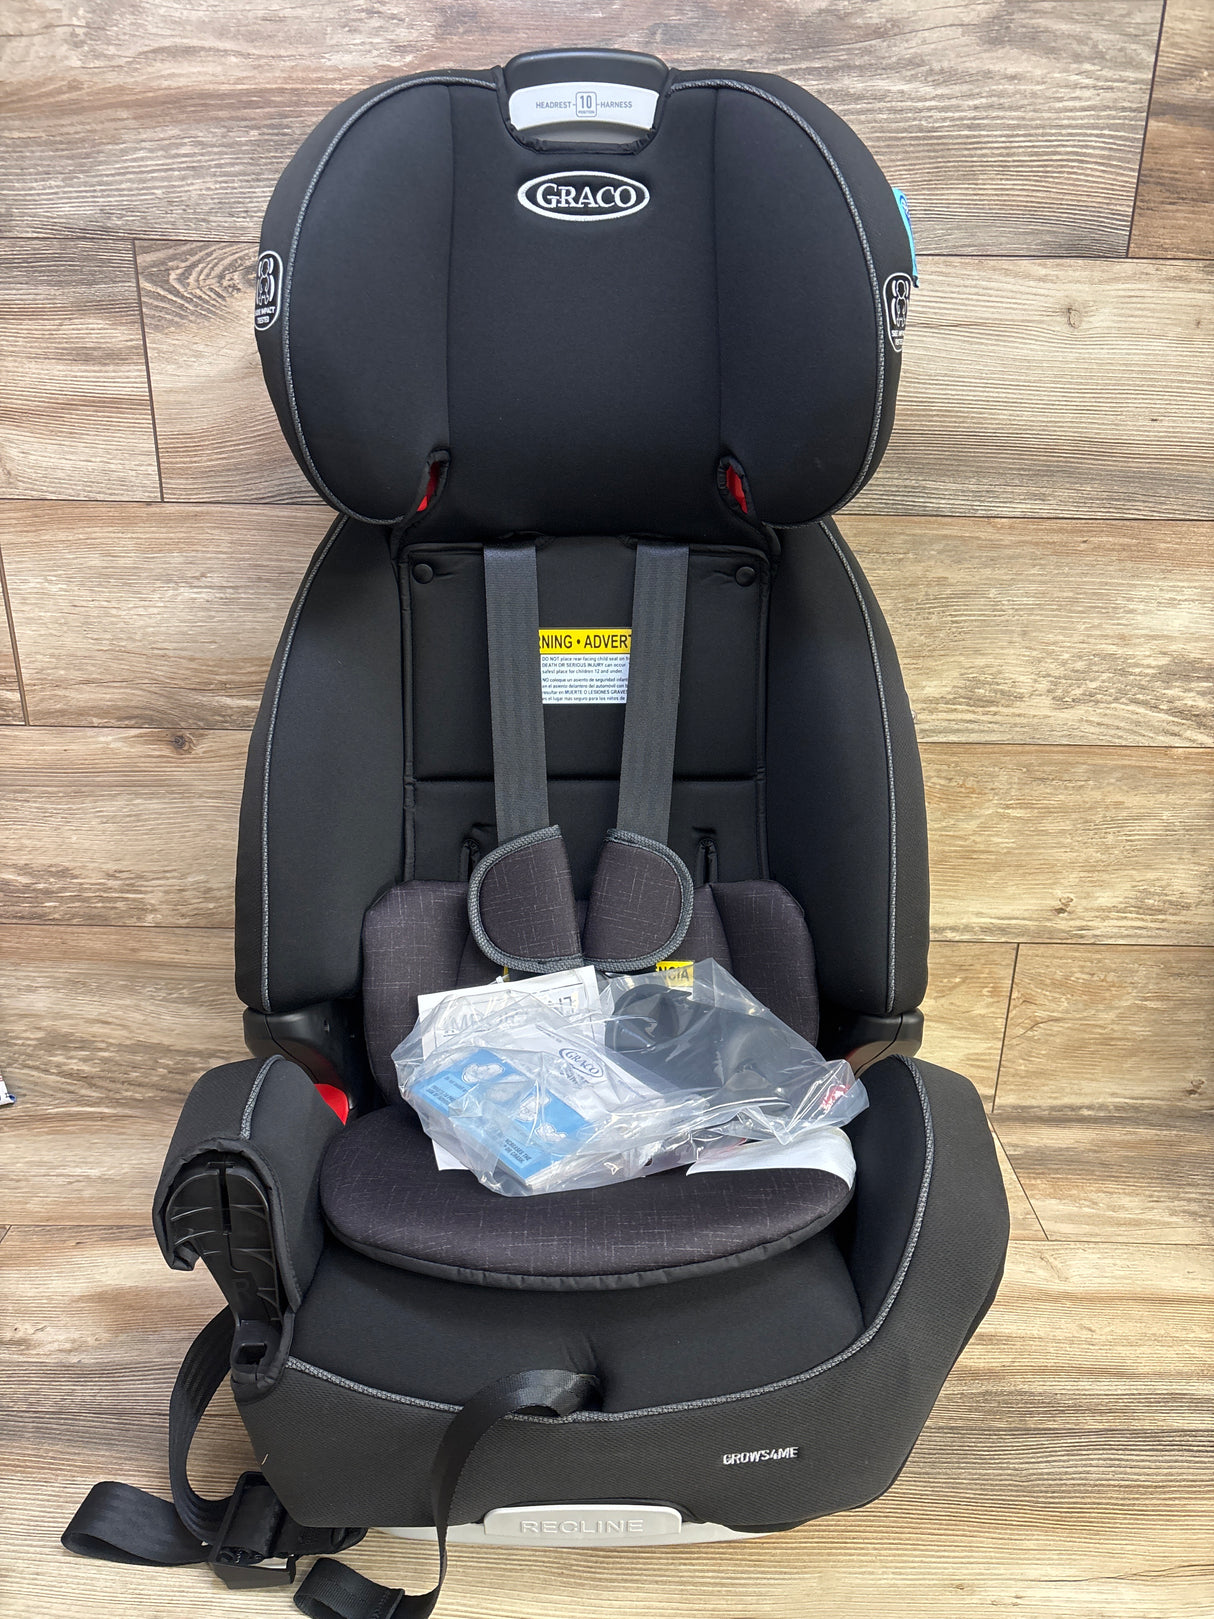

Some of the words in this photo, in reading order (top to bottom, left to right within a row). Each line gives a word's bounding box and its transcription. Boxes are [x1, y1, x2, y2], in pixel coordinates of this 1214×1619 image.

[535, 100, 571, 109] HEADREST
[579, 94, 592, 109] 10
[600, 101, 633, 109] HARNESS
[536, 183, 637, 208] GRACO
[540, 634, 573, 649] NING
[722, 1446, 799, 1465] GROWS4ME
[519, 1519, 644, 1534] RECLINE
